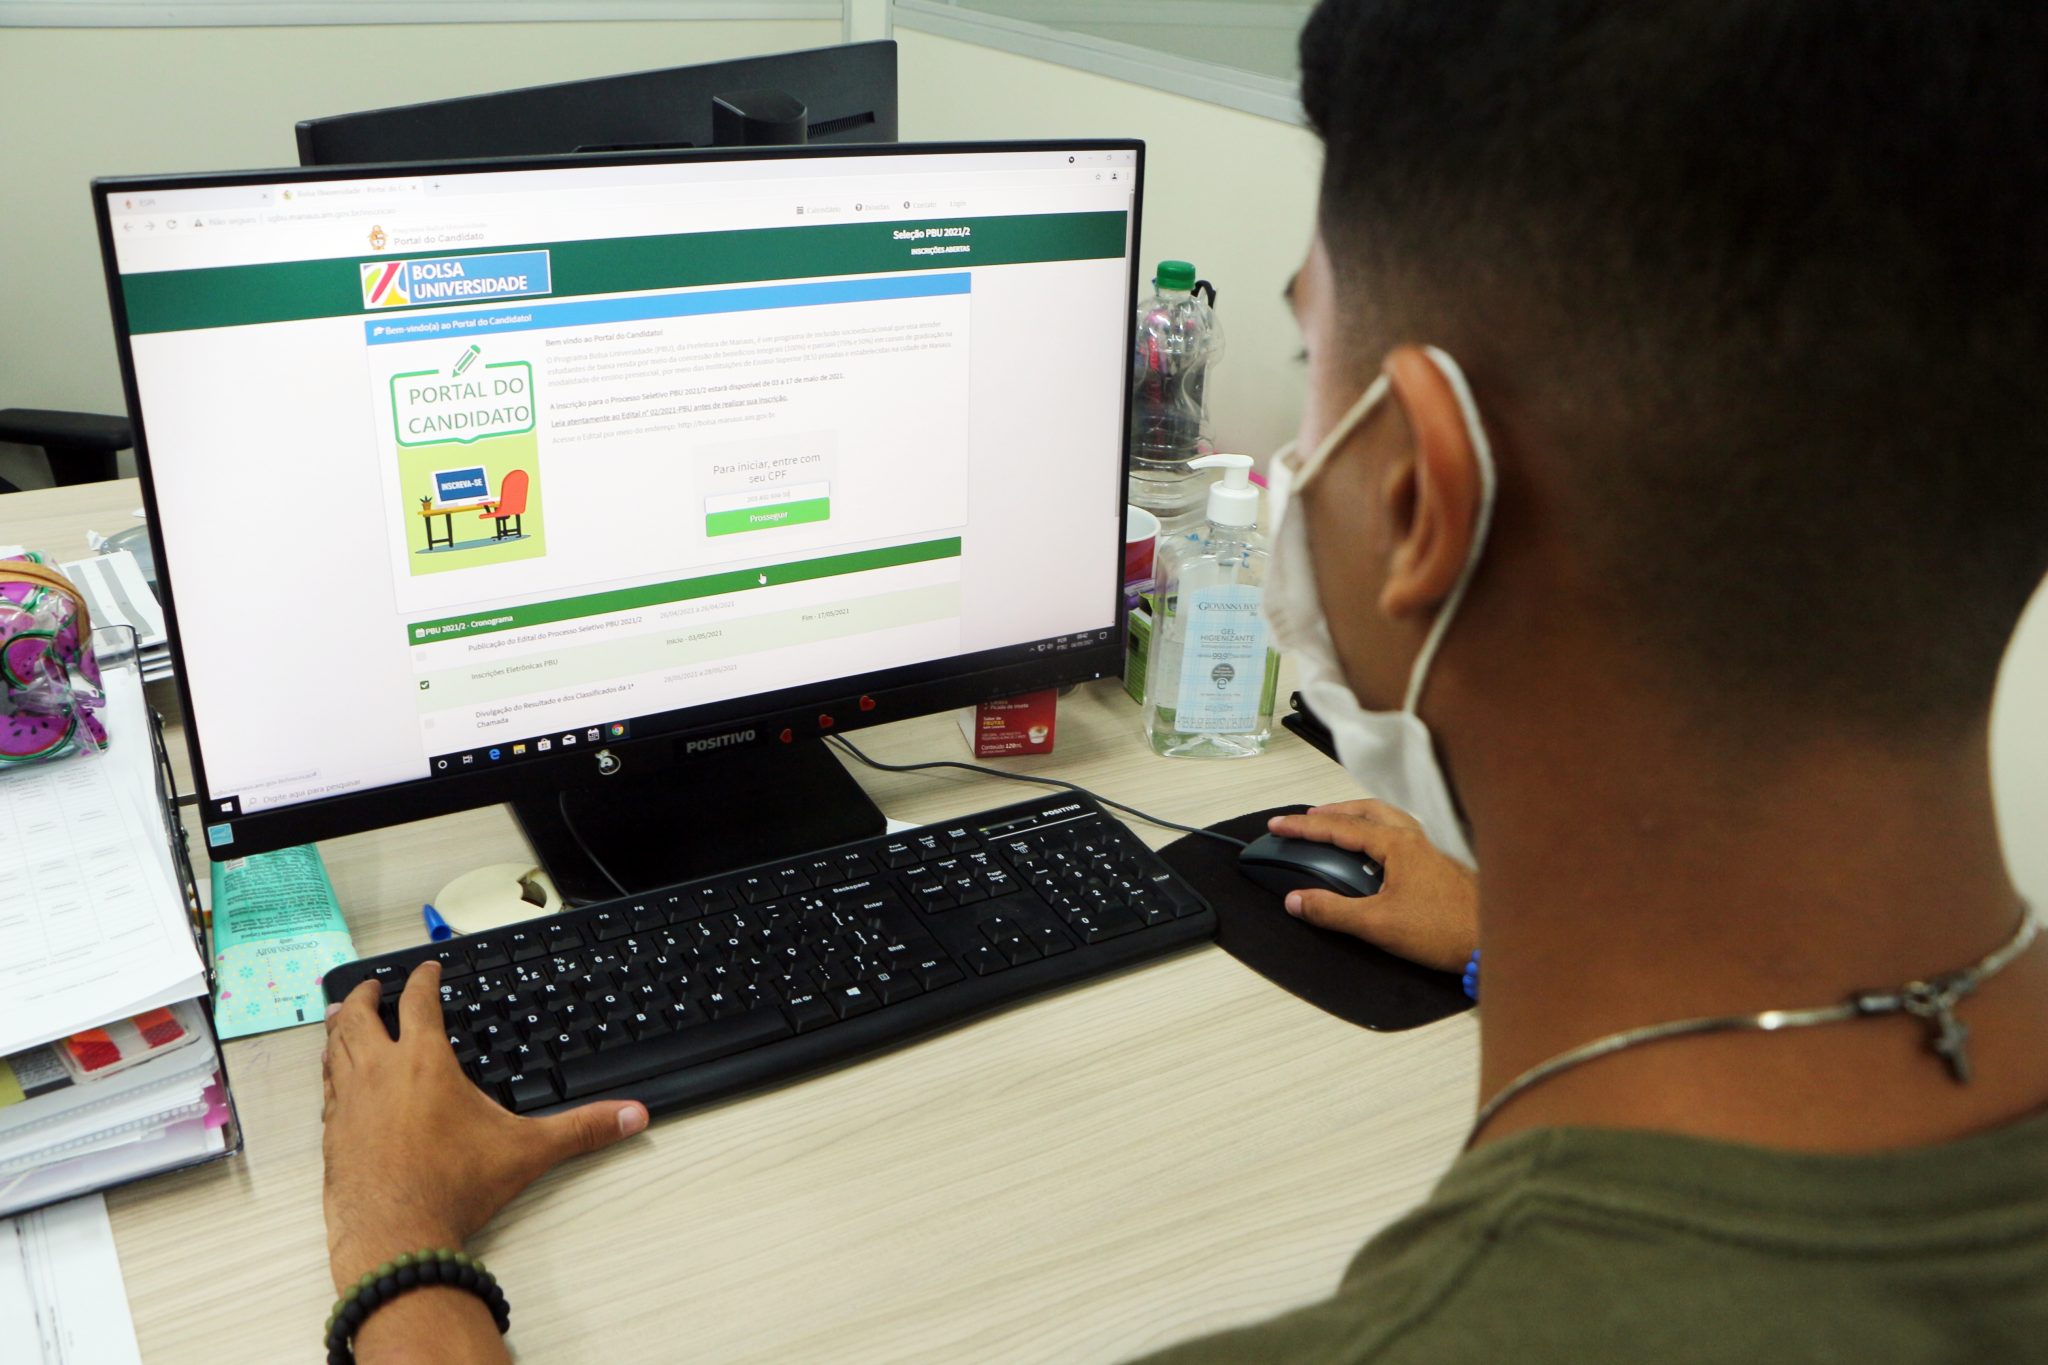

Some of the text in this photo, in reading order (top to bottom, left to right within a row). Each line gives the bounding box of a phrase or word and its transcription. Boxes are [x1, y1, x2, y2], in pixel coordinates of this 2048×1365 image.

[893, 226, 970, 240] Seleção PBU 2021/2
[394, 233, 484, 245] Portal do Candidato
[412, 262, 464, 280] BOLSA
[414, 276, 526, 298] UNIVERSIDADE
[383, 322, 439, 335] Bem-vindo(a)
[452, 319, 476, 328] Portal
[477, 318, 488, 326] do
[489, 314, 531, 325] Candidato!
[626, 330, 662, 338] Candidato!
[410, 377, 523, 404] PORTAL DO
[409, 406, 528, 433] CANDIDATO
[713, 454, 820, 474] Para iniciar, entre com
[749, 469, 786, 483] seu CPF
[441, 478, 482, 490] INSCREVA-SE
[749, 511, 787, 522] Prosseguir
[425, 616, 513, 635] PBU 2021/2 Cronograma
[468, 640, 505, 650] Publicação
[517, 634, 536, 643] Edital
[547, 628, 577, 637] Processo
[578, 624, 604, 632] Seletivo
[620, 616, 642, 625] 2021/2
[1200, 634, 1256, 642] HIGIENIZANTE
[471, 669, 504, 679] Inscrições
[506, 663, 542, 673] Eletrônicas
[475, 706, 512, 718] Divulgação
[523, 698, 556, 708] Resultado
[575, 687, 616, 699] Classificados
[477, 718, 508, 728] Chamada
[685, 729, 757, 754] POSITIVO
[262, 792, 288, 804] Digite
[289, 789, 306, 800] aqui
[307, 785, 326, 797] para
[326, 779, 361, 792] pesquisar
[1041, 803, 1082, 818] POSITIVO
[938, 859, 957, 867] Home
[906, 866, 926, 875] Insert
[1152, 873, 1170, 882] Enter
[832, 881, 870, 894] Backspace
[922, 885, 943, 894] Delete
[863, 901, 883, 909] Enter
[887, 944, 906, 952] Shift
[657, 956, 667, 964] U
[750, 957, 761, 965] L
[921, 960, 937, 968] Ctrl
[620, 965, 629, 973] Y
[715, 966, 727, 974] K
[583, 974, 592, 982] T
[680, 975, 688, 984] J
[545, 984, 556, 992] R
[642, 985, 653, 993] H
[507, 994, 517, 1002] E
[605, 995, 616, 1003] G
[711, 993, 723, 1001] M
[468, 1002, 481, 1012] W
[566, 1004, 575, 1013] F
[673, 1003, 685, 1012] N
[527, 1014, 538, 1023] D
[636, 1013, 647, 1022] B
[488, 1025, 498, 1033] S
[597, 1023, 607, 1032] V
[450, 1036, 460, 1044] A
[559, 1033, 570, 1042] C
[519, 1044, 529, 1053] X
[479, 1055, 490, 1064] Z
[511, 1074, 524, 1082] Alt
